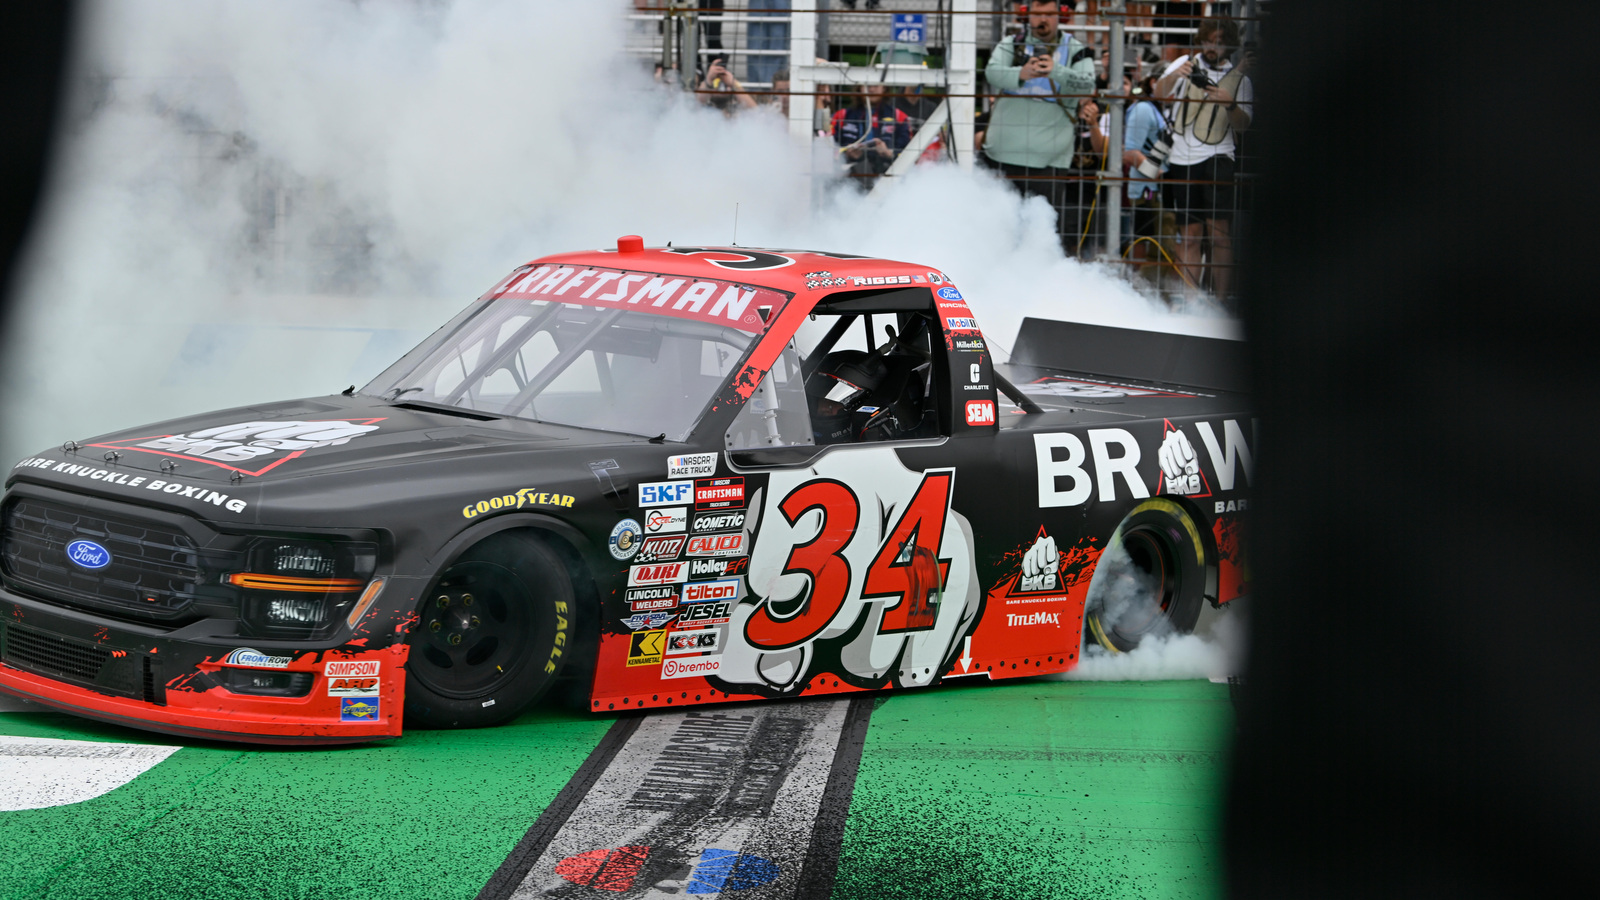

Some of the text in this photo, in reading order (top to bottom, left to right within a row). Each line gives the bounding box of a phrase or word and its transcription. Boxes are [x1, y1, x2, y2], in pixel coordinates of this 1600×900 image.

[897, 29, 920, 42] 46
[854, 275, 911, 286] RIGGS
[494, 265, 757, 321] CRAFTSMAN
[943, 288, 960, 299] Ford
[948, 318, 970, 328] Mobil
[967, 403, 994, 422] SEM
[683, 456, 711, 466] NASCAR
[671, 466, 712, 475] RACE TRUCK
[52, 462, 147, 487] KNUCKLE
[146, 480, 247, 513] BOXING
[1165, 475, 1200, 495] BKB
[641, 484, 691, 503] SKF
[697, 487, 743, 499] CRAFTSMAN
[463, 488, 575, 518] GOODYEAR
[694, 514, 744, 529] COMETIC
[642, 538, 682, 554] KLOTZ
[688, 535, 742, 552] CALICO
[74, 543, 102, 564] Ford
[743, 467, 956, 650] 34
[637, 562, 686, 581] DART
[692, 560, 727, 576] Holley
[1021, 574, 1056, 591] BKB
[628, 588, 671, 600] LINCOLN
[686, 585, 734, 600] tilton
[636, 600, 673, 609] WELDERS
[681, 603, 731, 621] JESEL
[545, 601, 568, 674] EAGLE
[327, 662, 377, 675] SIMPSON
[628, 657, 660, 665] KENNAMETAL
[679, 660, 719, 673] brembo
[330, 678, 378, 688] ARP
